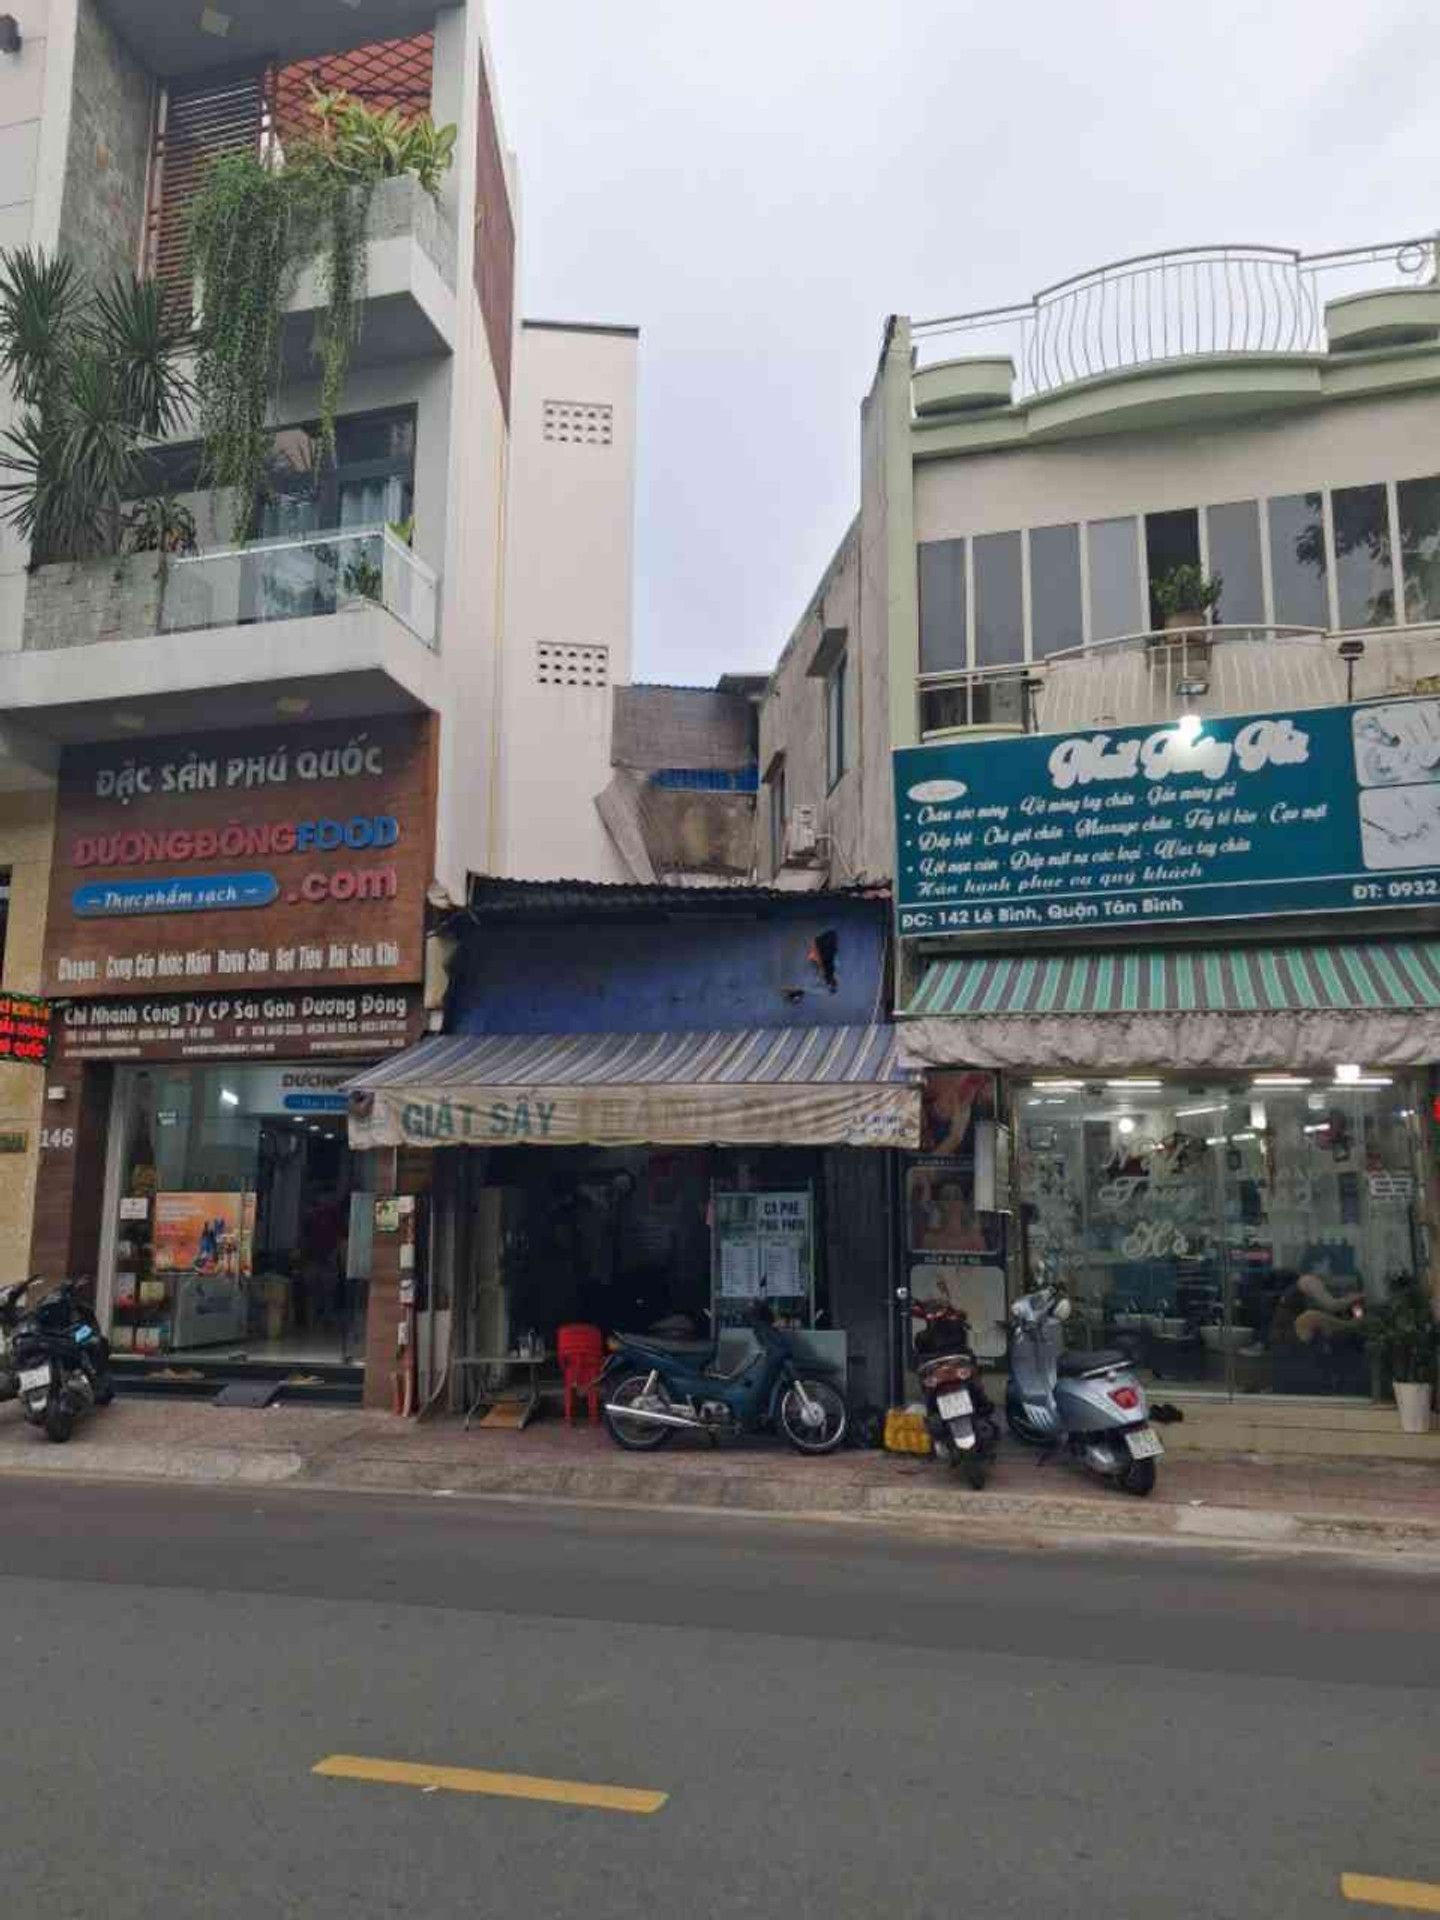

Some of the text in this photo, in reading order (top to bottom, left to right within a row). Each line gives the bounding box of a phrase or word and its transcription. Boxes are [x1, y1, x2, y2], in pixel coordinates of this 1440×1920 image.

[161, 751, 217, 793] SẢN
[225, 743, 288, 788] PHÚ
[297, 732, 384, 779] QUỐC
[287, 865, 398, 905] .com
[1352, 883, 1384, 900] ĐT:
[901, 912, 933, 929] ĐC:
[938, 910, 971, 926] 142
[974, 906, 993, 924] Lê
[1047, 901, 1098, 921] Quận
[1103, 898, 1137, 917] Tân
[1142, 895, 1184, 914] Bình
[208, 1001, 230, 1022] CP
[40, 1127, 74, 1149] 146
